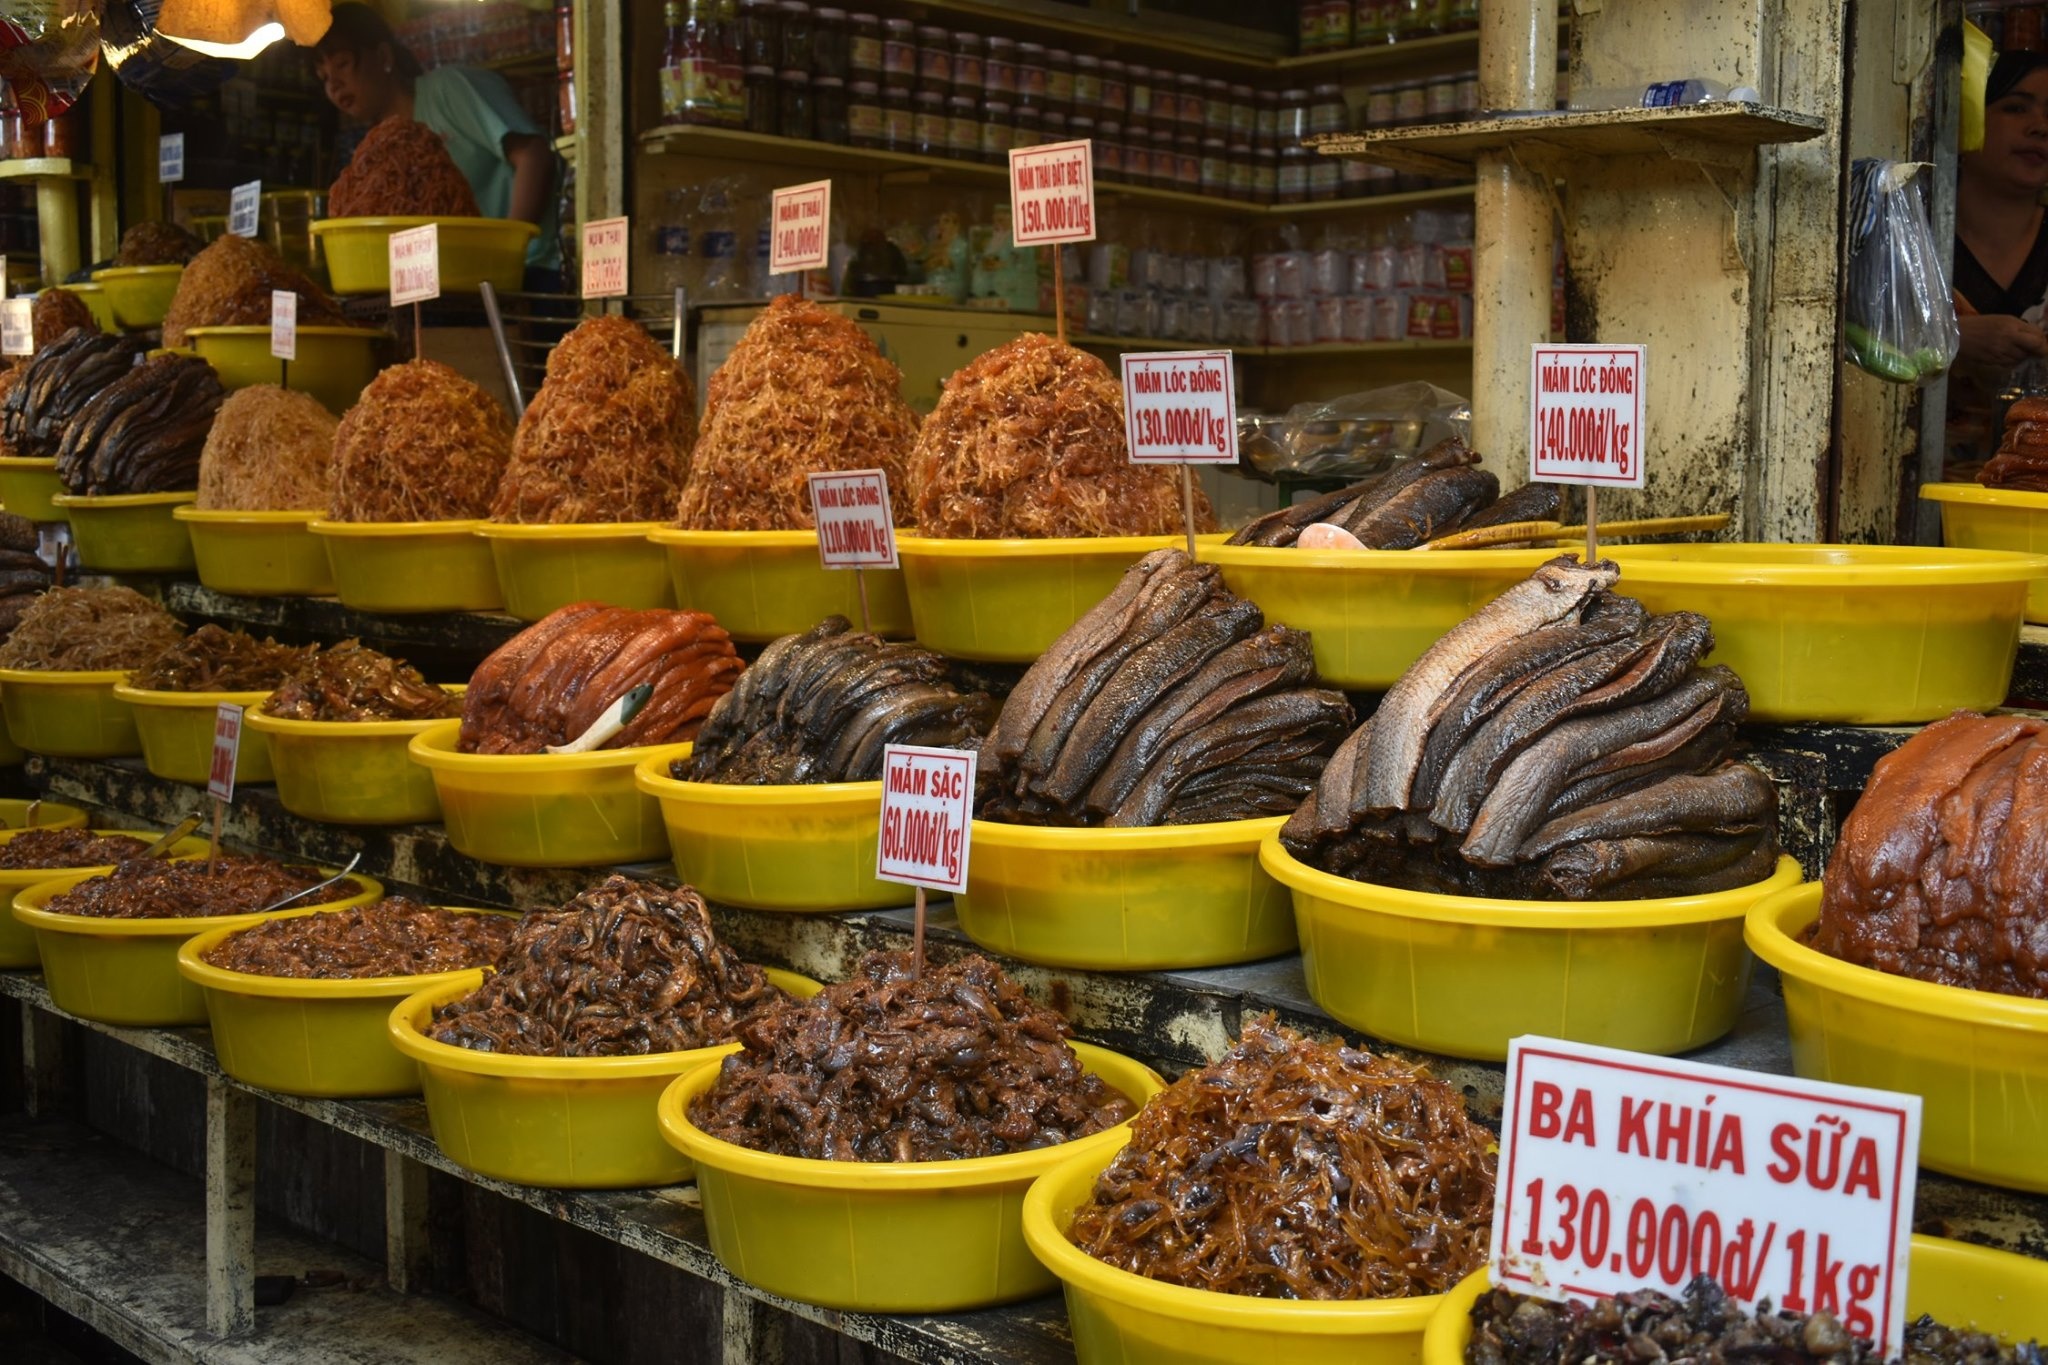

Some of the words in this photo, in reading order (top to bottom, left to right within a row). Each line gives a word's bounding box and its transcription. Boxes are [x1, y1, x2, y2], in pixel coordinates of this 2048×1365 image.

[1134, 362, 1161, 393] MẮM
[1164, 365, 1186, 393] LÓC
[1189, 361, 1222, 392] ĐỒNG
[1543, 354, 1569, 392] MẮM
[1573, 358, 1596, 393] LÓC
[1600, 354, 1632, 394] ĐỒNG
[890, 756, 926, 796] MẮM
[931, 765, 962, 806] SẶC
[1529, 1080, 1597, 1148] BA
[1617, 1094, 1746, 1175] KHÍA
[1766, 1114, 1881, 1200] SỮA
